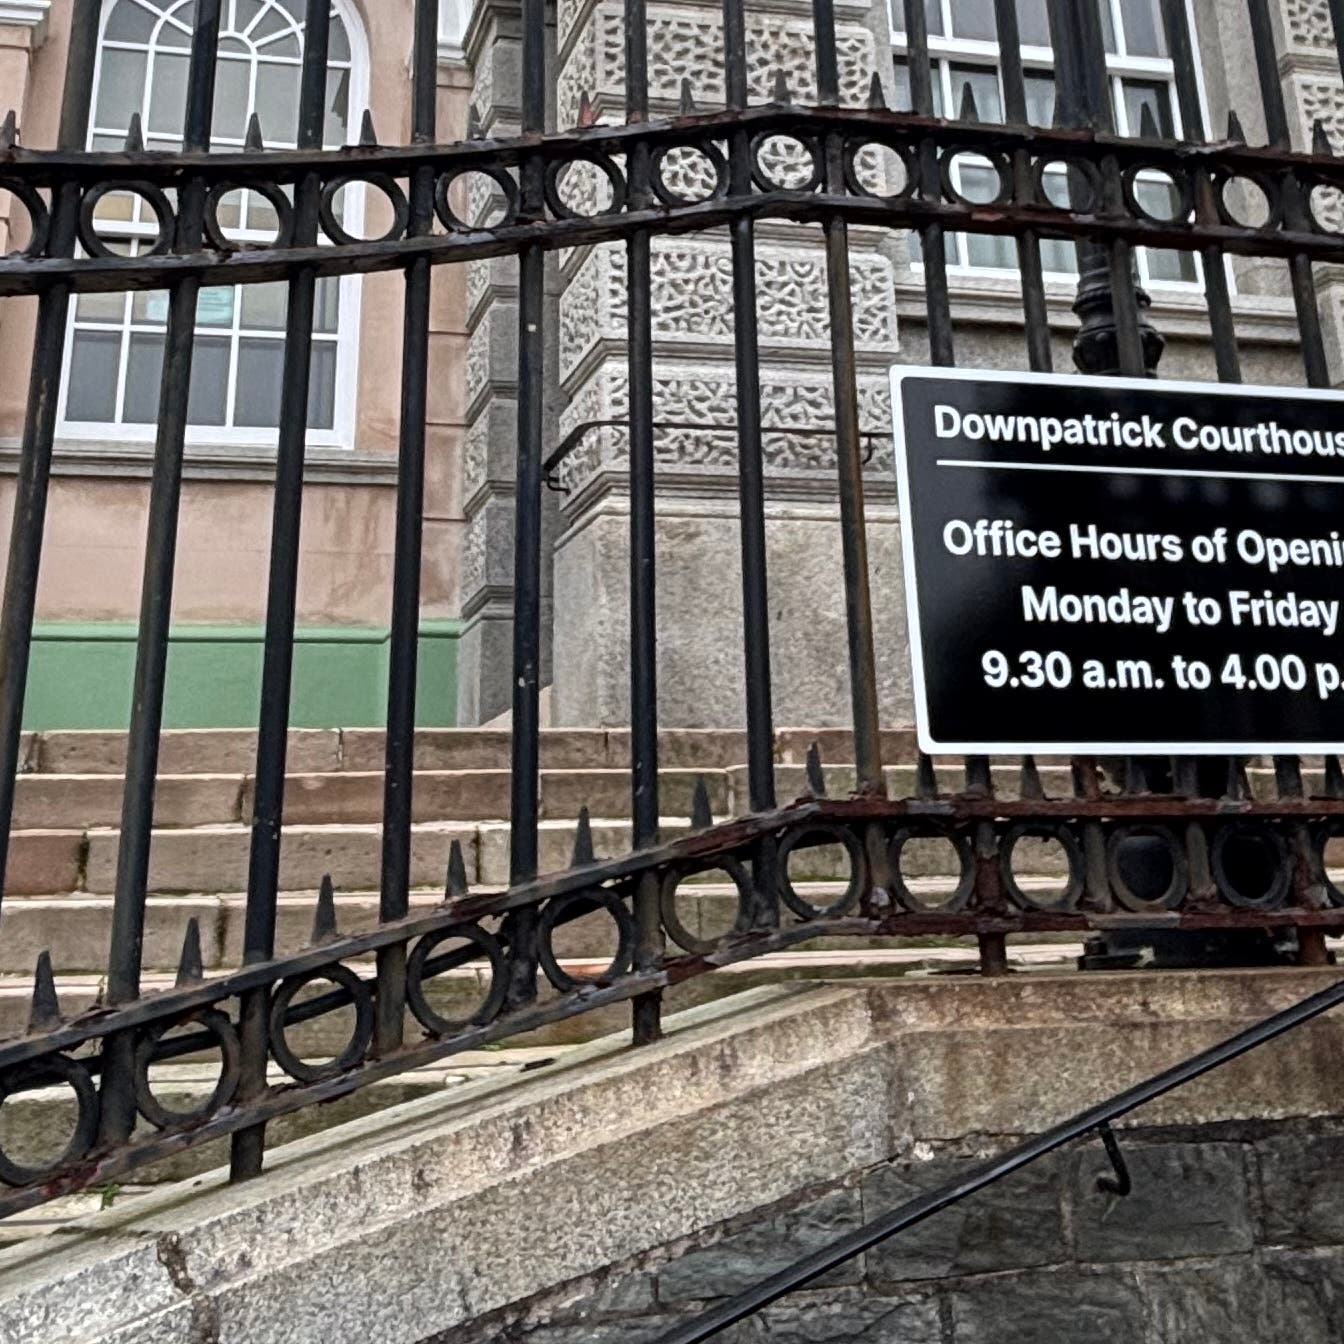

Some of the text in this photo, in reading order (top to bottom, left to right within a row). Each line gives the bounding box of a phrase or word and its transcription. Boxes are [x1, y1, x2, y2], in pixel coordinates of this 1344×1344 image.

[933, 404, 1166, 451] Downpatrick
[942, 518, 1062, 558] Office
[1069, 523, 1184, 562] Hours
[1191, 527, 1228, 563] of
[1021, 585, 1339, 636] Monday to Friday
[981, 649, 1072, 689] 9.30
[1082, 659, 1165, 689] a.m.
[1171, 654, 1212, 690] to
[1220, 653, 1307, 691] 4.00
